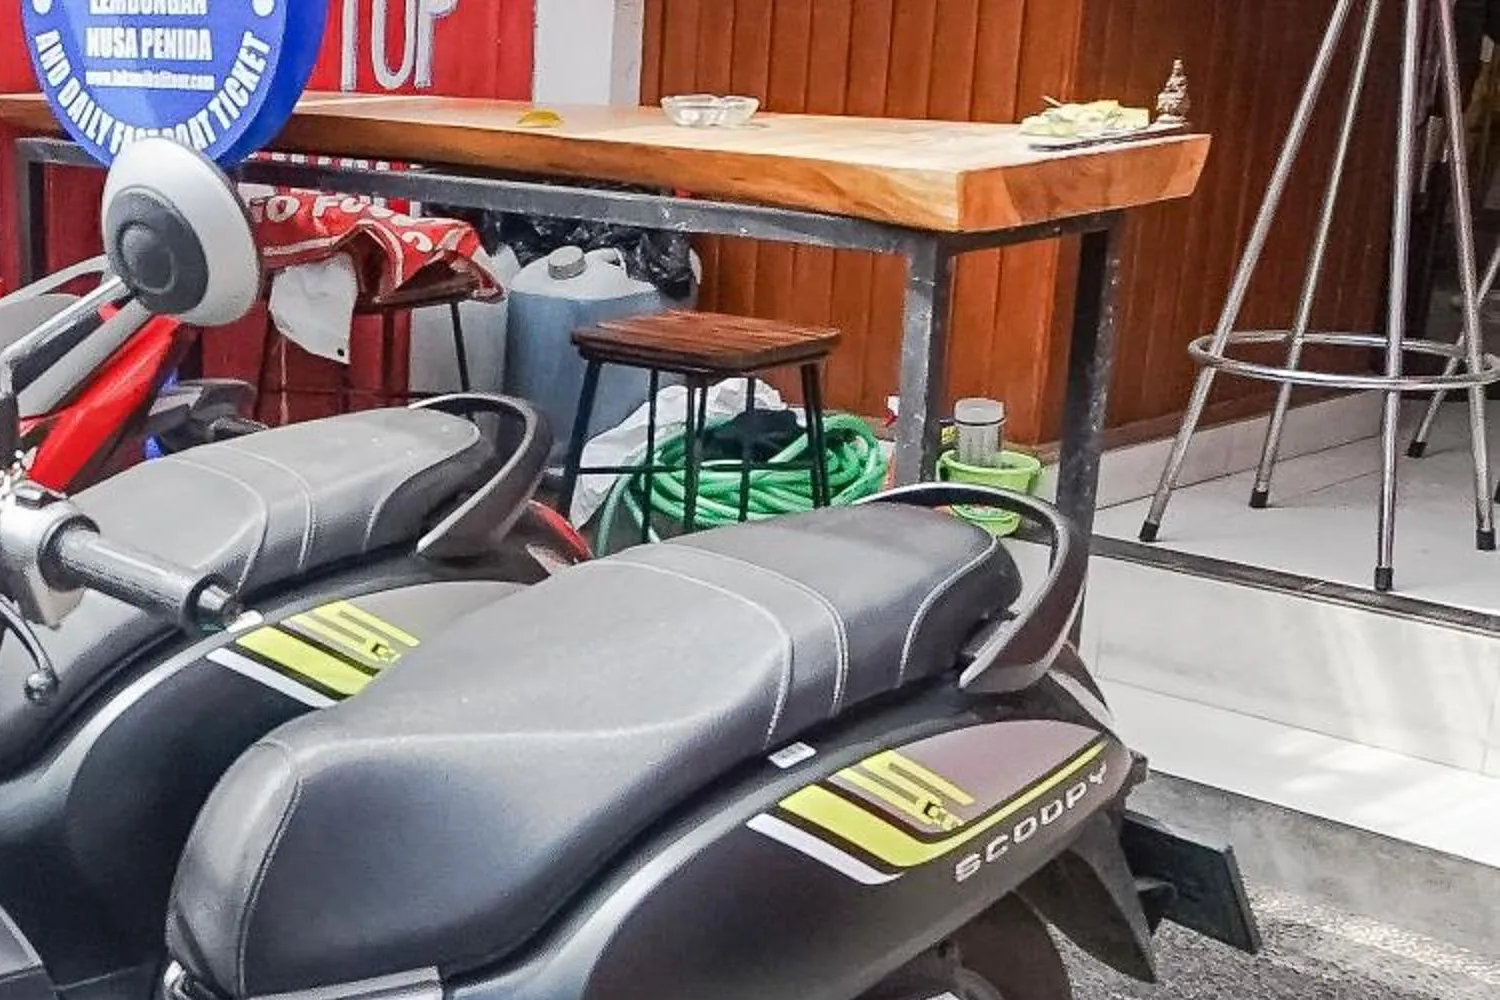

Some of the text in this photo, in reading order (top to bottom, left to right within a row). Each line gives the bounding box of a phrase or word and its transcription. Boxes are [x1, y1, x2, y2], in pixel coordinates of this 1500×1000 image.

[35, 30, 70, 87] AND
[58, 77, 113, 146] DAILY
[207, 31, 271, 130] TICKET
[86, 27, 213, 60] NUSA PENIDA
[954, 760, 1108, 883] SCOOPY
